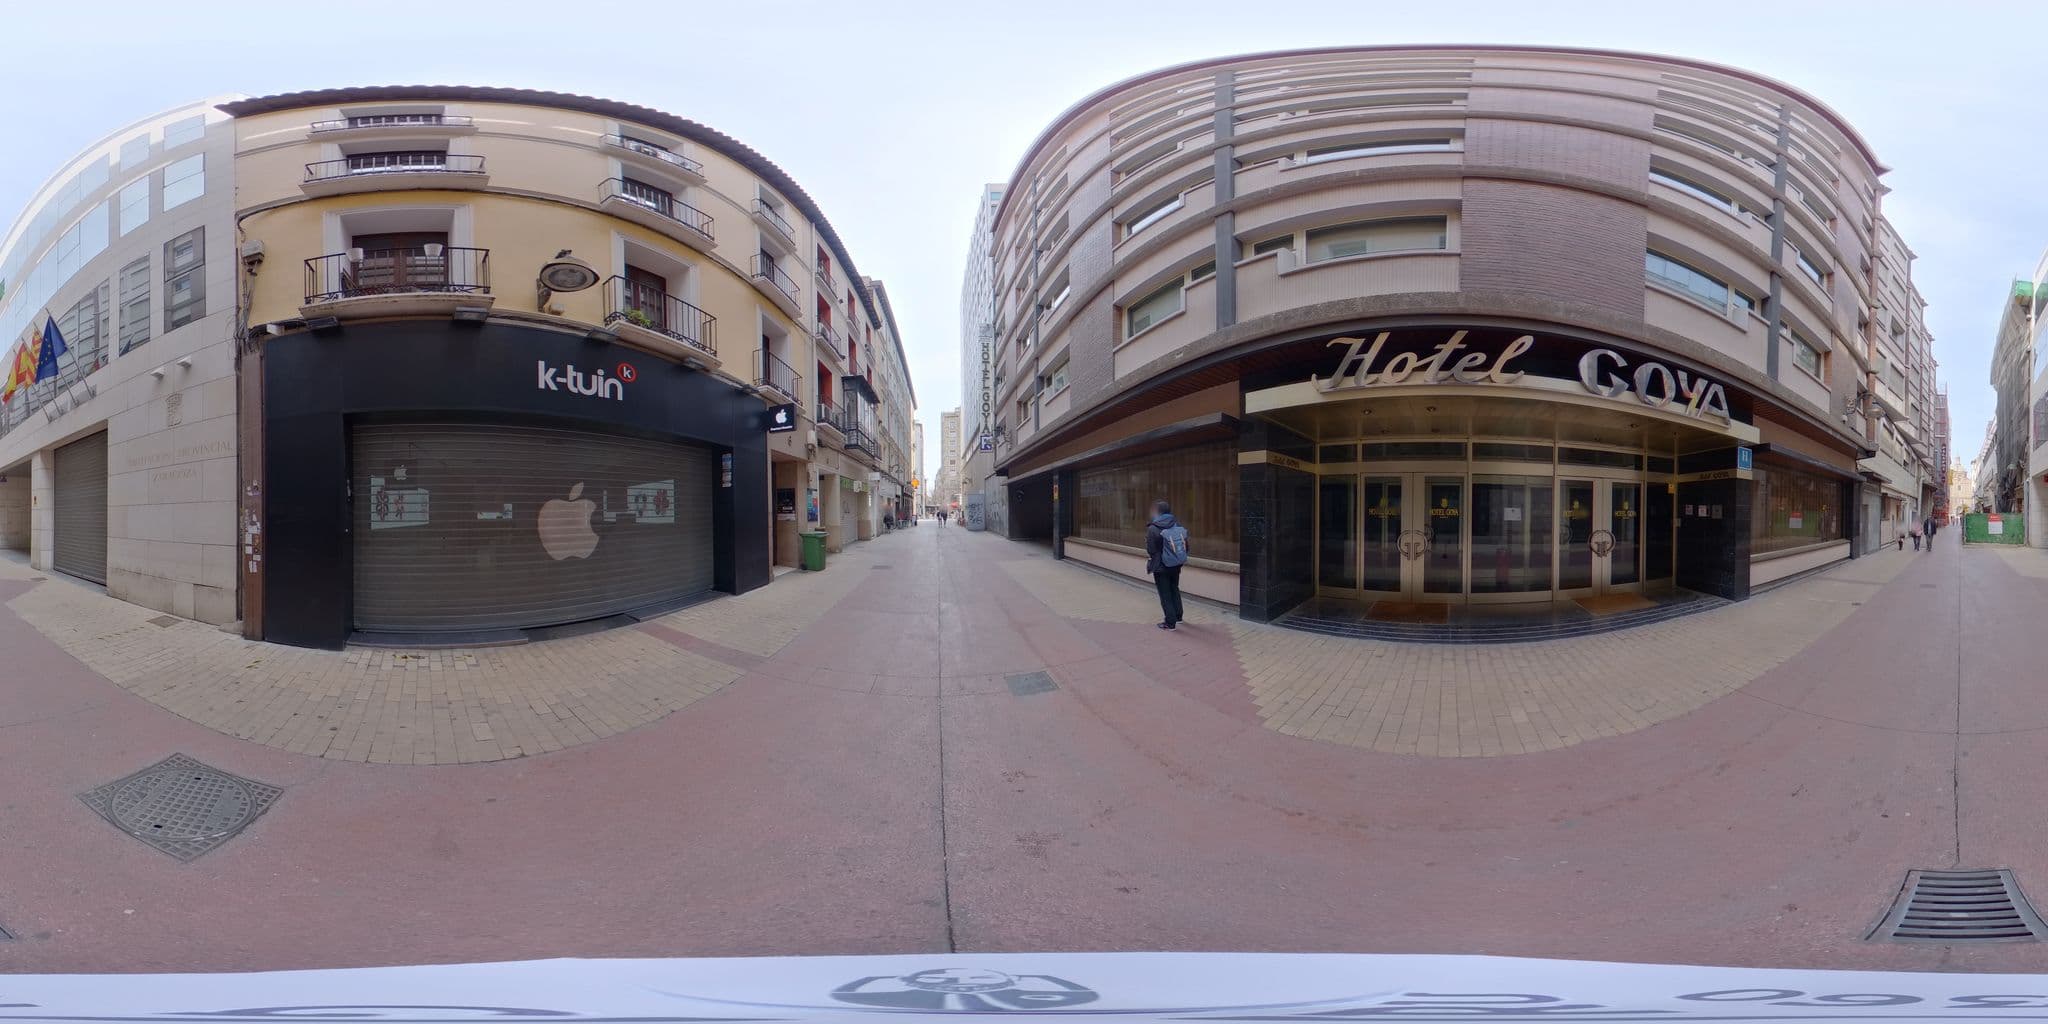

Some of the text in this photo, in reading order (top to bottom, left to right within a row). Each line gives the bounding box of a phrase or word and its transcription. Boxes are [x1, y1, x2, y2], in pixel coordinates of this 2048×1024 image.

[538, 360, 623, 401] k-tuin
[623, 366, 632, 379] k
[981, 343, 991, 434] HOTEL GOYA
[1311, 330, 1732, 430] Hotel GOYA
[1742, 450, 1749, 462] H
